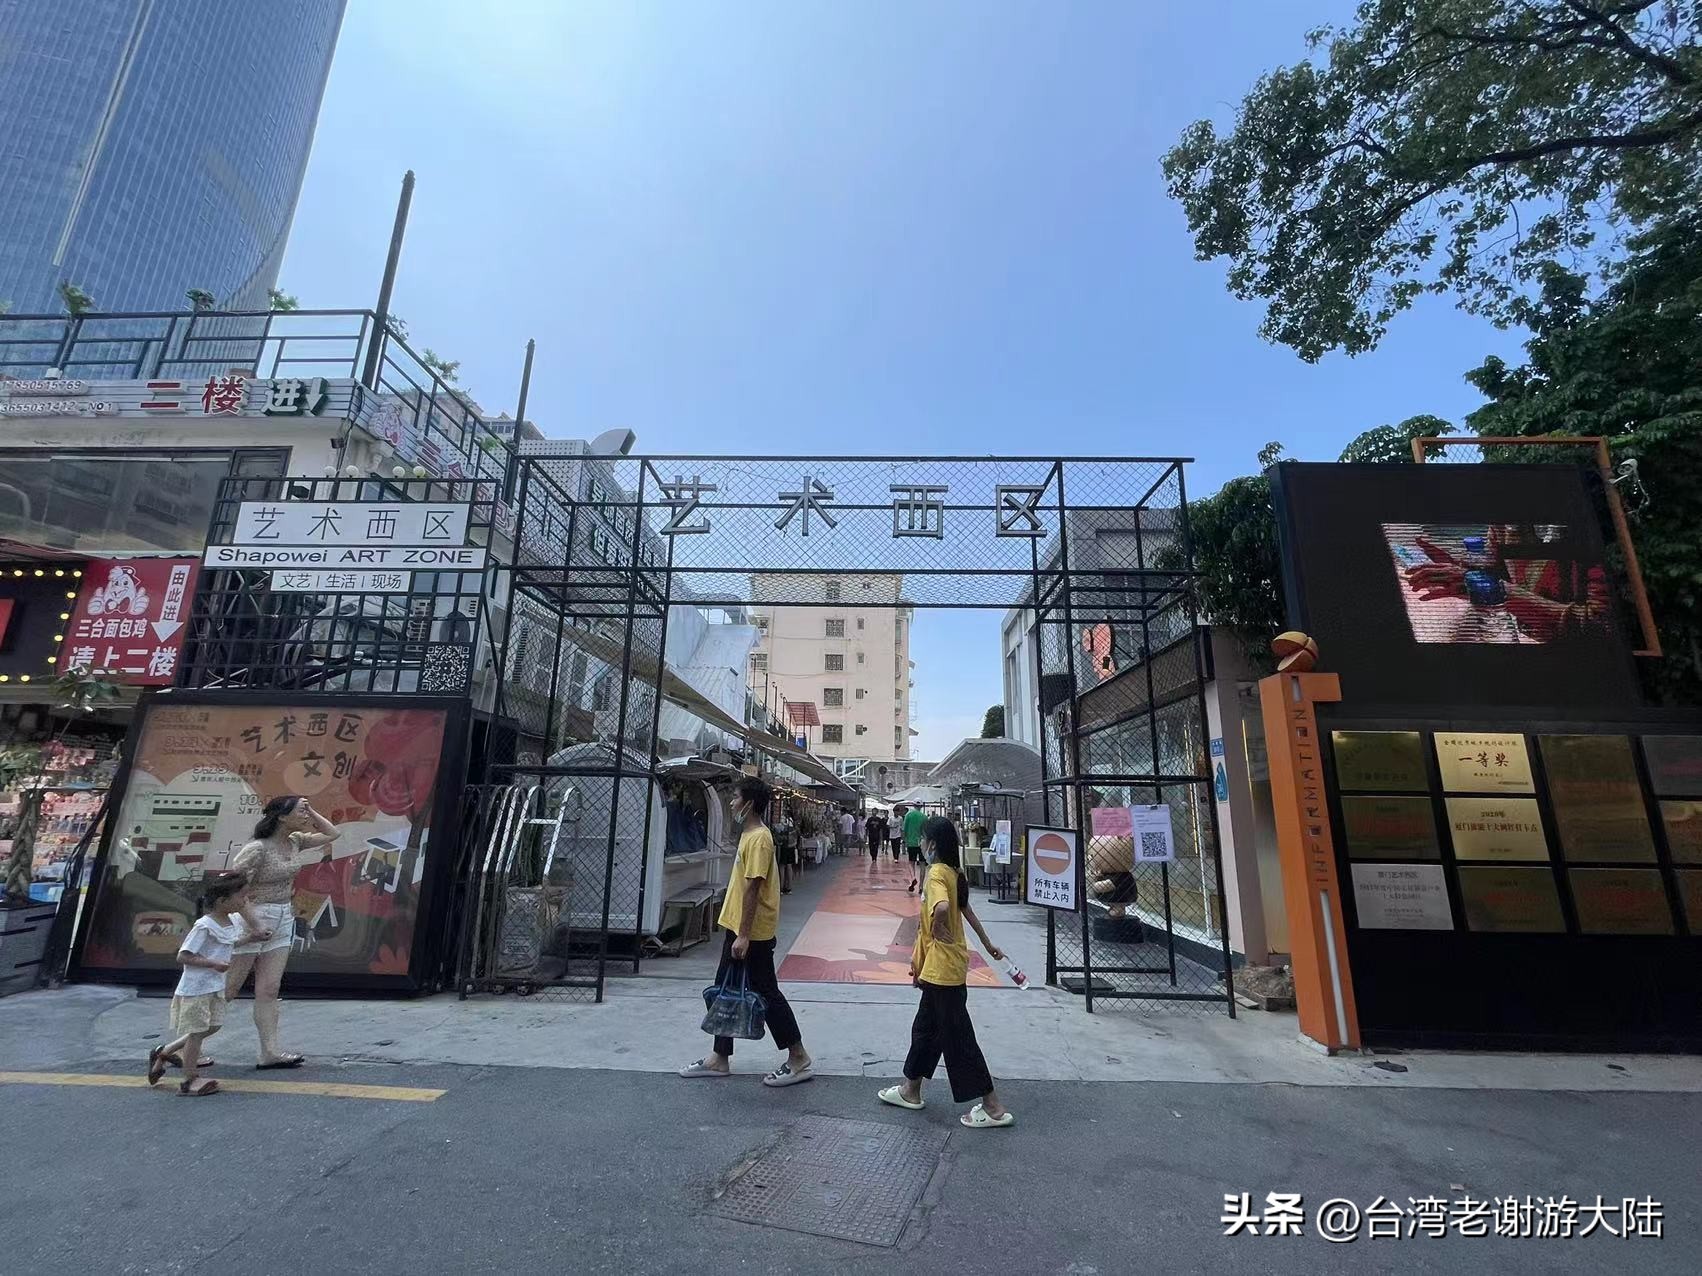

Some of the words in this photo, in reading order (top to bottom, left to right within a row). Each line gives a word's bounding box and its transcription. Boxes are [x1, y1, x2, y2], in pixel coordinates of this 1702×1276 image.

[659, 475, 1048, 541] 艺术西区
[252, 507, 455, 540] 艺术西区
[218, 548, 327, 563] Shapowei
[339, 550, 393, 563] ART
[402, 550, 473, 564] ZONE
[76, 618, 147, 638] 三合面包鸡
[240, 713, 363, 753] 艺术西区
[301, 751, 357, 780] 文创
[1458, 751, 1509, 768] 一等奖
[1034, 877, 1070, 891] 所有车辆
[1034, 888, 1070, 902] 禁止入内
